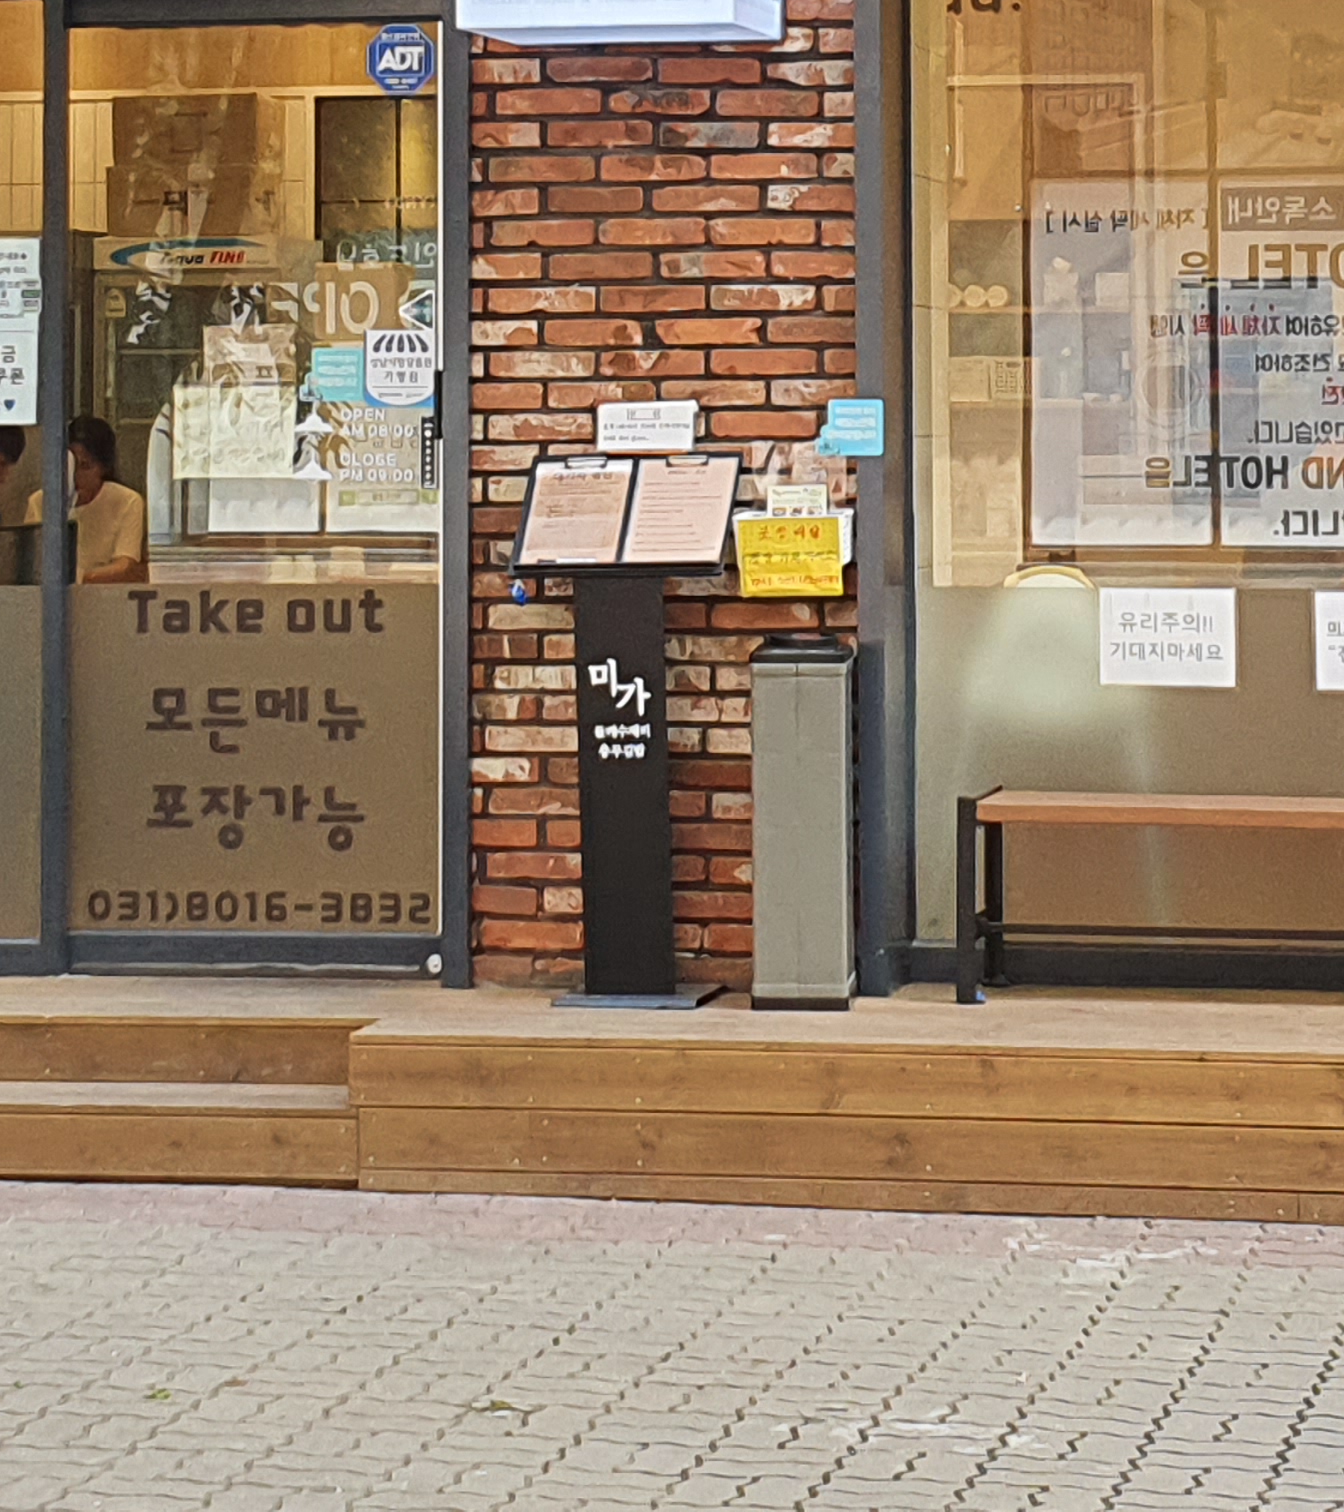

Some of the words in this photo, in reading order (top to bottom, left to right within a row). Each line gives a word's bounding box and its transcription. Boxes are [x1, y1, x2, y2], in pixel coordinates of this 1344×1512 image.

[377, 45, 425, 72] ADT
[340, 409, 387, 422] OPEN
[128, 589, 265, 635] Take
[286, 589, 385, 635] out
[1109, 640, 1224, 663] 기대지마세요
[587, 657, 652, 717] 미가
[145, 687, 366, 753] 모든메뉴
[146, 784, 366, 851] 포장가능
[87, 890, 432, 924] 031)8016-3832
